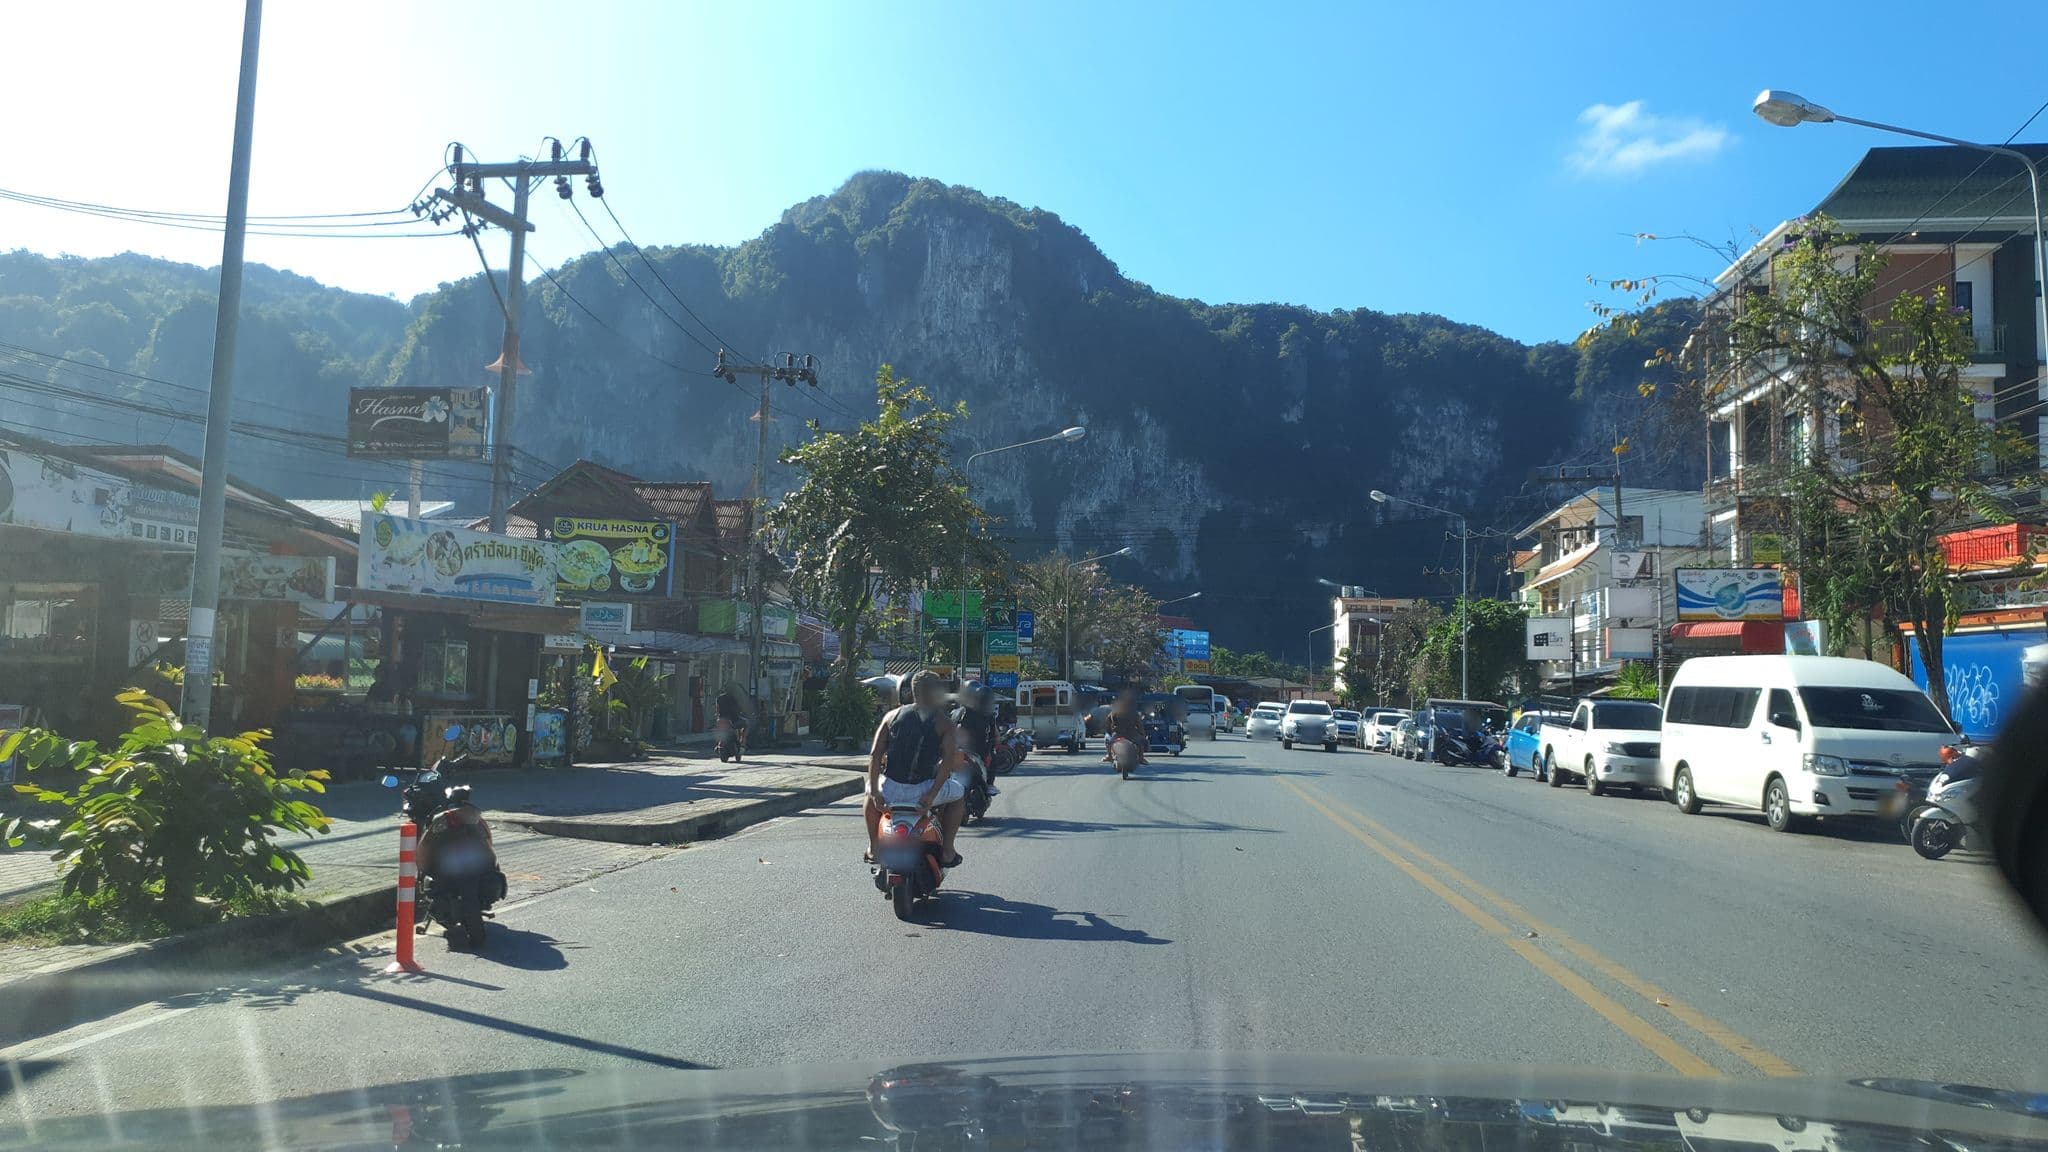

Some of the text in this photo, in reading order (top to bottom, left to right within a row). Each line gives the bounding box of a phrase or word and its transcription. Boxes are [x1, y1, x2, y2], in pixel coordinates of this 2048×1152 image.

[355, 397, 422, 415] Hasna
[577, 521, 609, 532] KRUA
[611, 524, 649, 534] HASNA
